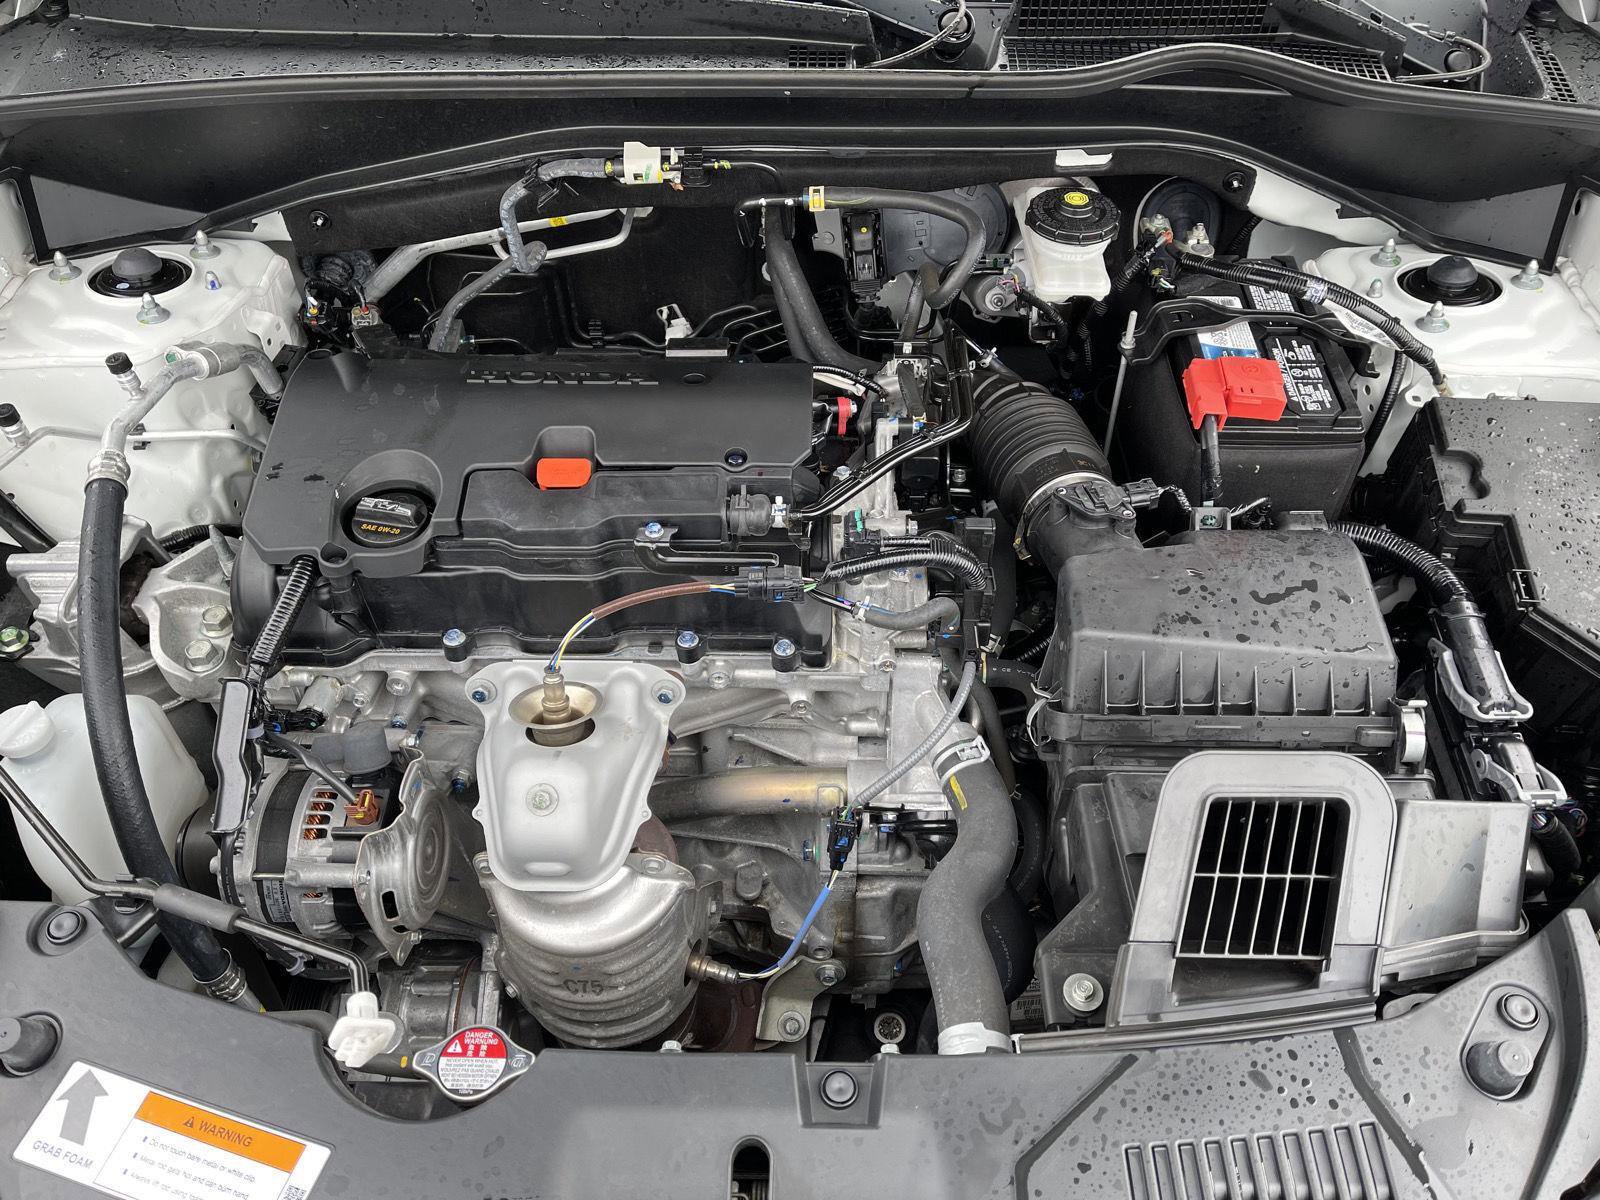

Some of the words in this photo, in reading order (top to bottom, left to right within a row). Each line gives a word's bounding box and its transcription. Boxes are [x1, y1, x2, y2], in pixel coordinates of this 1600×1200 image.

[361, 523, 377, 532] SAE
[377, 525, 401, 535] 0W-20
[464, 1031, 494, 1039] DANGER
[198, 1119, 254, 1148] WARNING
[149, 1138, 159, 1147] Do
[32, 1140, 62, 1158] GRAB
[62, 1150, 94, 1170] FOAM
